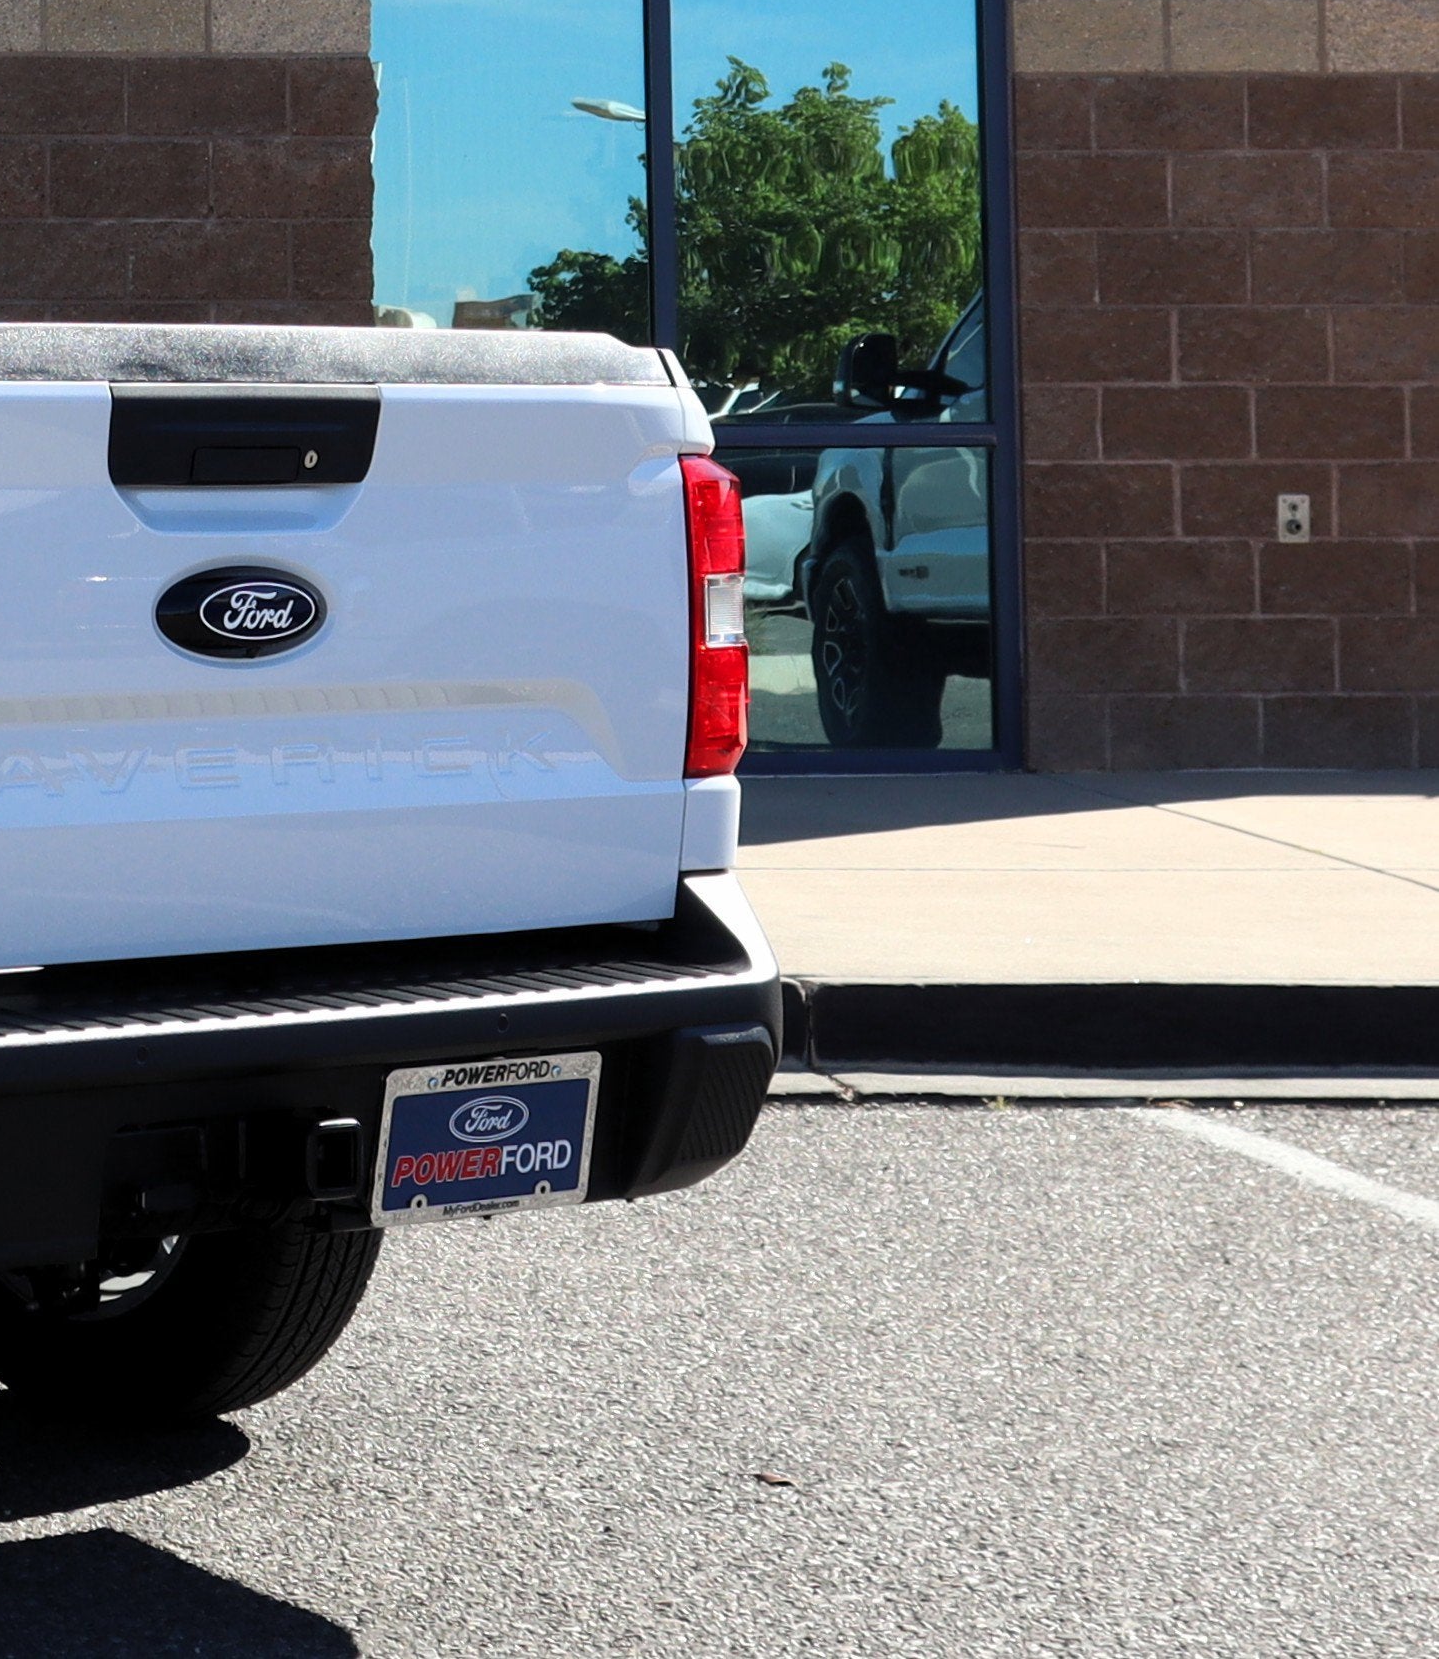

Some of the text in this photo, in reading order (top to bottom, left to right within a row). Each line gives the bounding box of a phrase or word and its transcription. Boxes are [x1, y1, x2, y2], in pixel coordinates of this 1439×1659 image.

[223, 591, 293, 632] Ford
[442, 1060, 550, 1087] POWERFORD
[465, 1105, 511, 1133] Ford
[392, 1140, 571, 1187] POWERFORD
